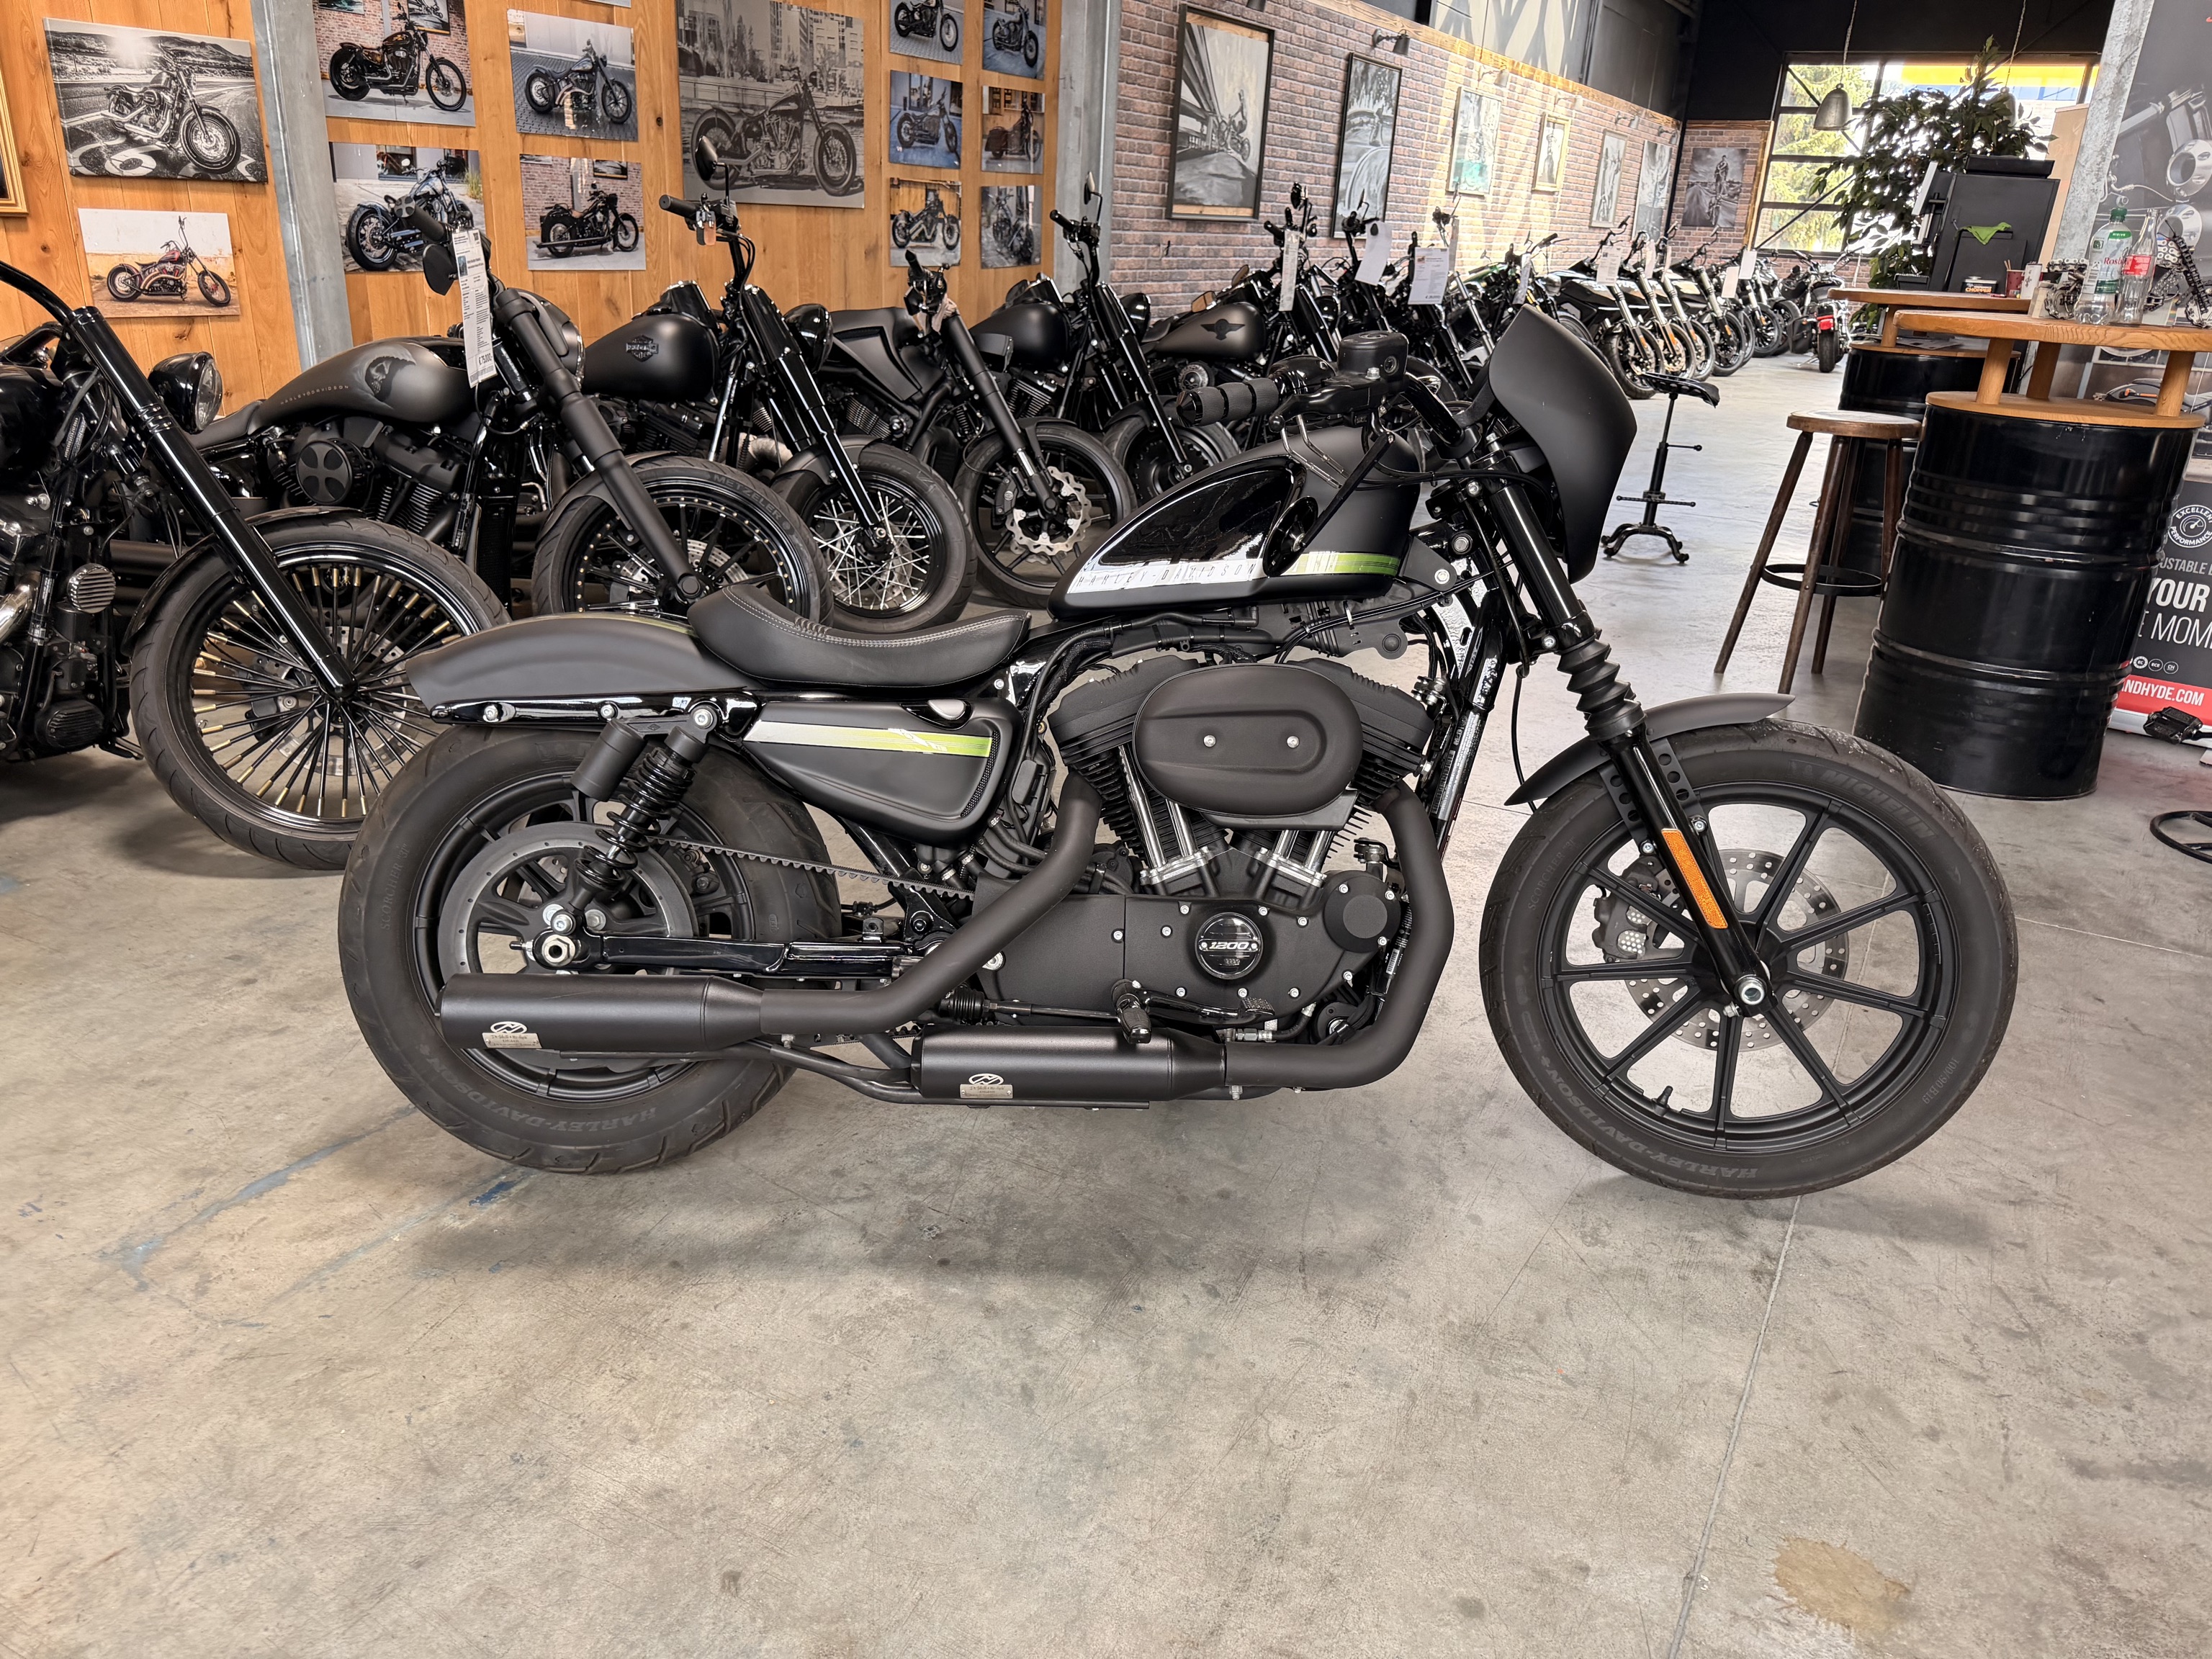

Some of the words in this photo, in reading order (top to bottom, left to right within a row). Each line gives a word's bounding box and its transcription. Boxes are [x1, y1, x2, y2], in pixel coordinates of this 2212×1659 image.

[714, 474, 783, 520] METZELER
[2170, 526, 2212, 545] PERFORMANCE
[1076, 563, 1256, 587] HARLEY-DAVIDSON
[2146, 577, 2211, 613] YOUR
[2150, 613, 2212, 649] MOM
[1819, 769, 1938, 838] MICHELIN
[381, 863, 403, 930] SCORCHER
[1527, 852, 1565, 911] SCORCHER
[1209, 941, 1250, 950] 1200
[1936, 1057, 1960, 1088] 100/90
[426, 1057, 657, 1132] HARLEY-DAVIDSON
[1922, 1087, 1939, 1105] B19
[1548, 1066, 1759, 1179] HARLEY-DAVIDSON
